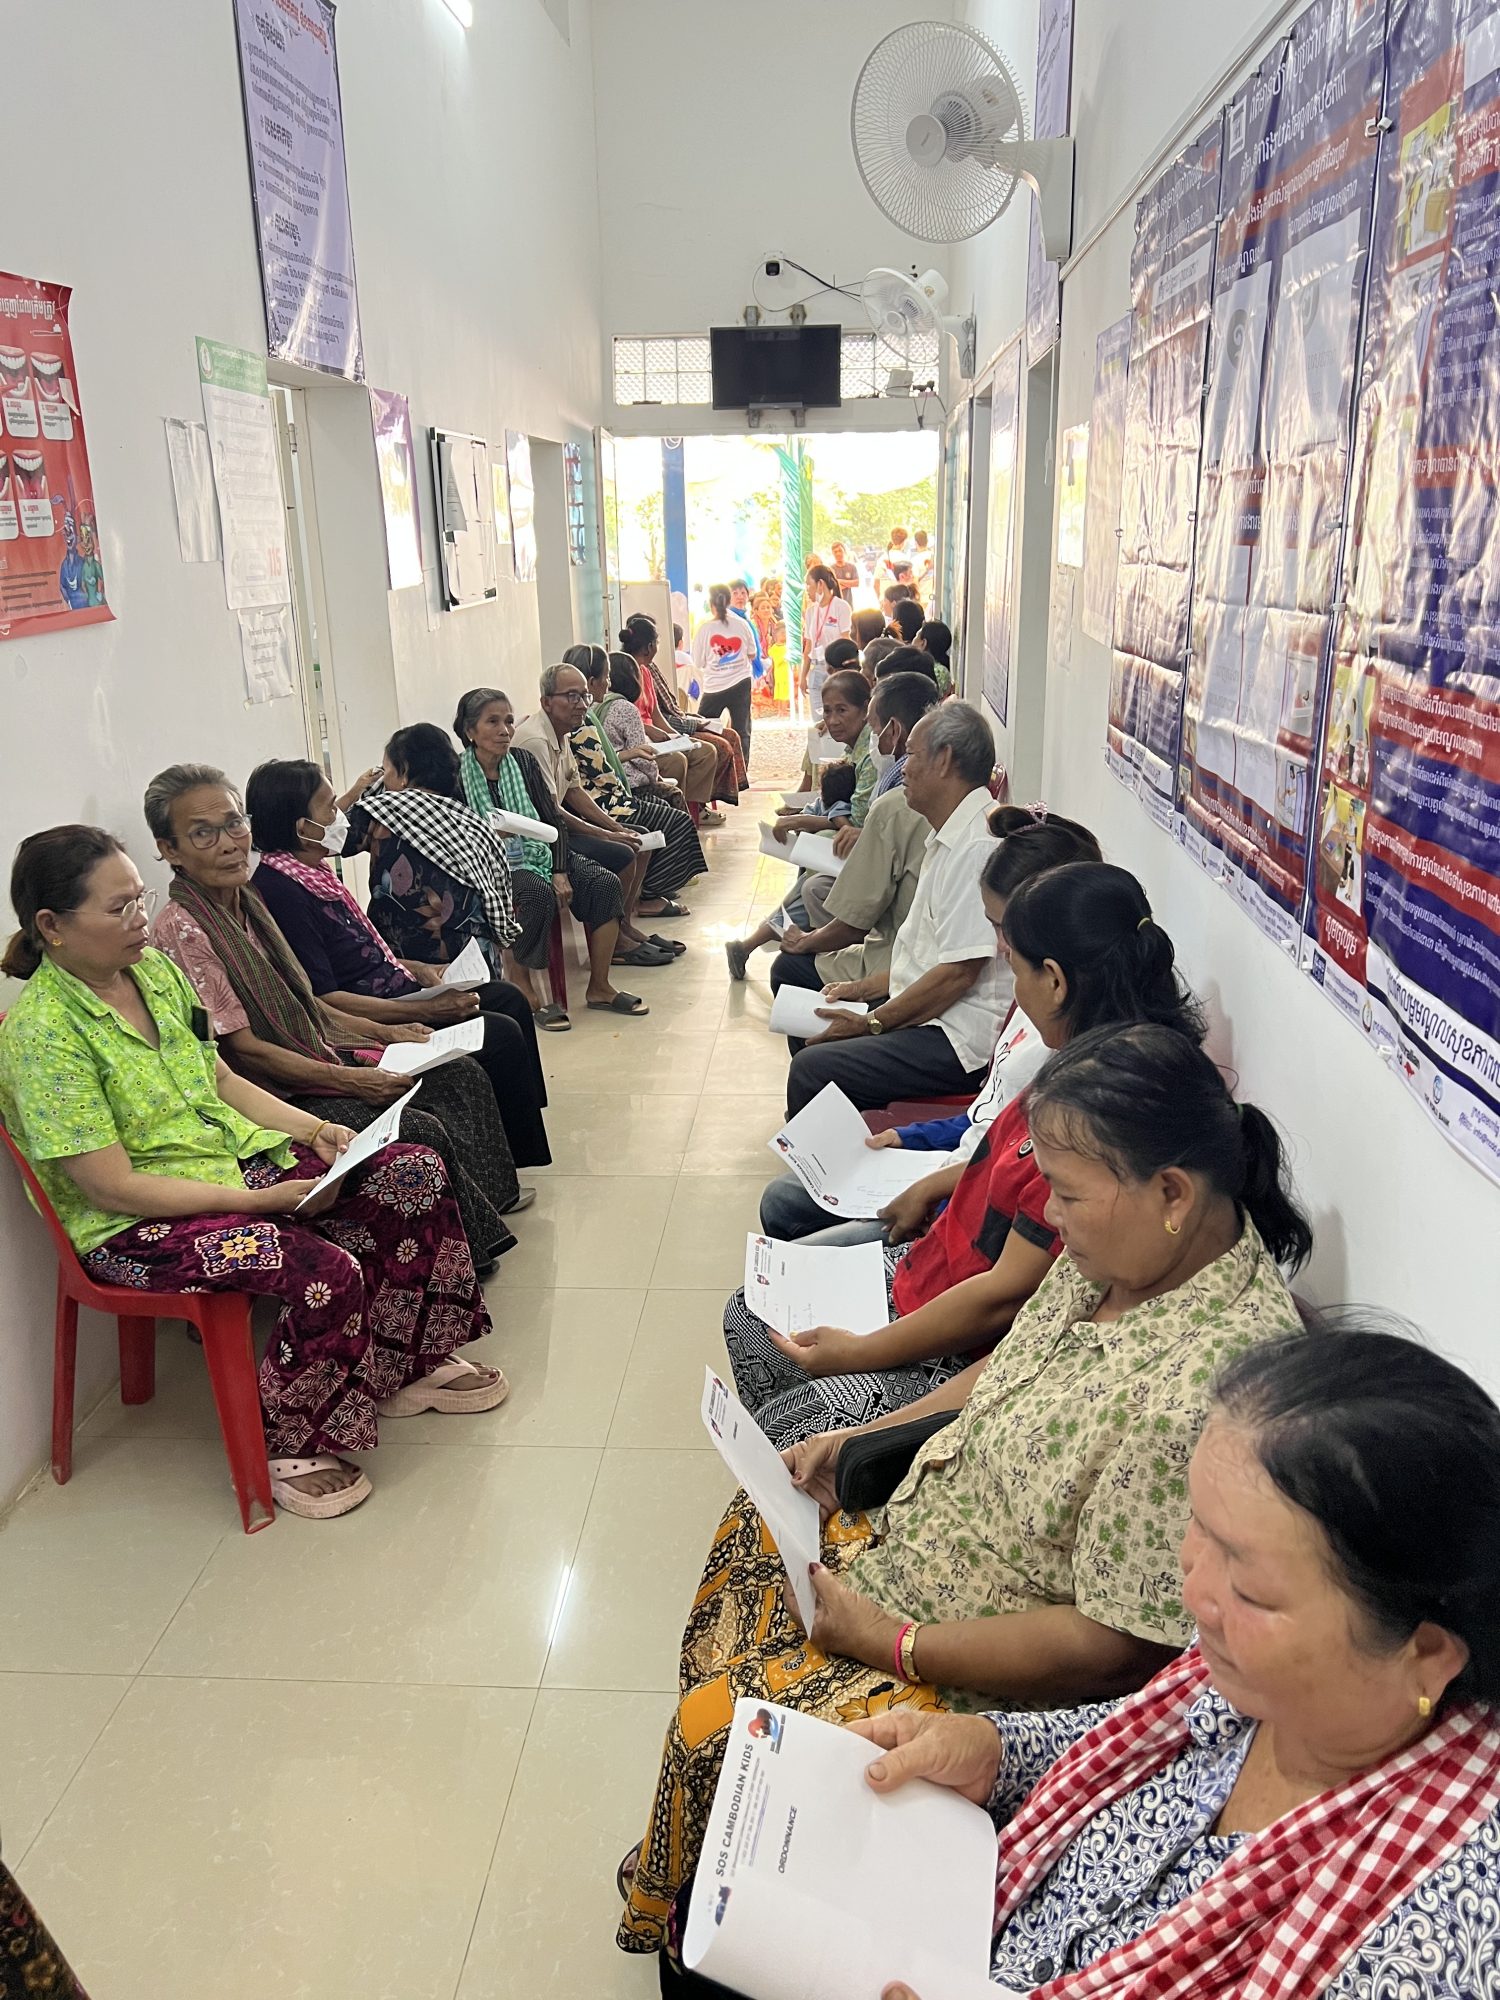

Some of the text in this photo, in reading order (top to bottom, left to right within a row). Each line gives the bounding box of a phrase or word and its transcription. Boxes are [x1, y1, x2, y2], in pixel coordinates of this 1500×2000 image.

[716, 1742, 754, 1878] SOS CAMBODIAN KIDS
